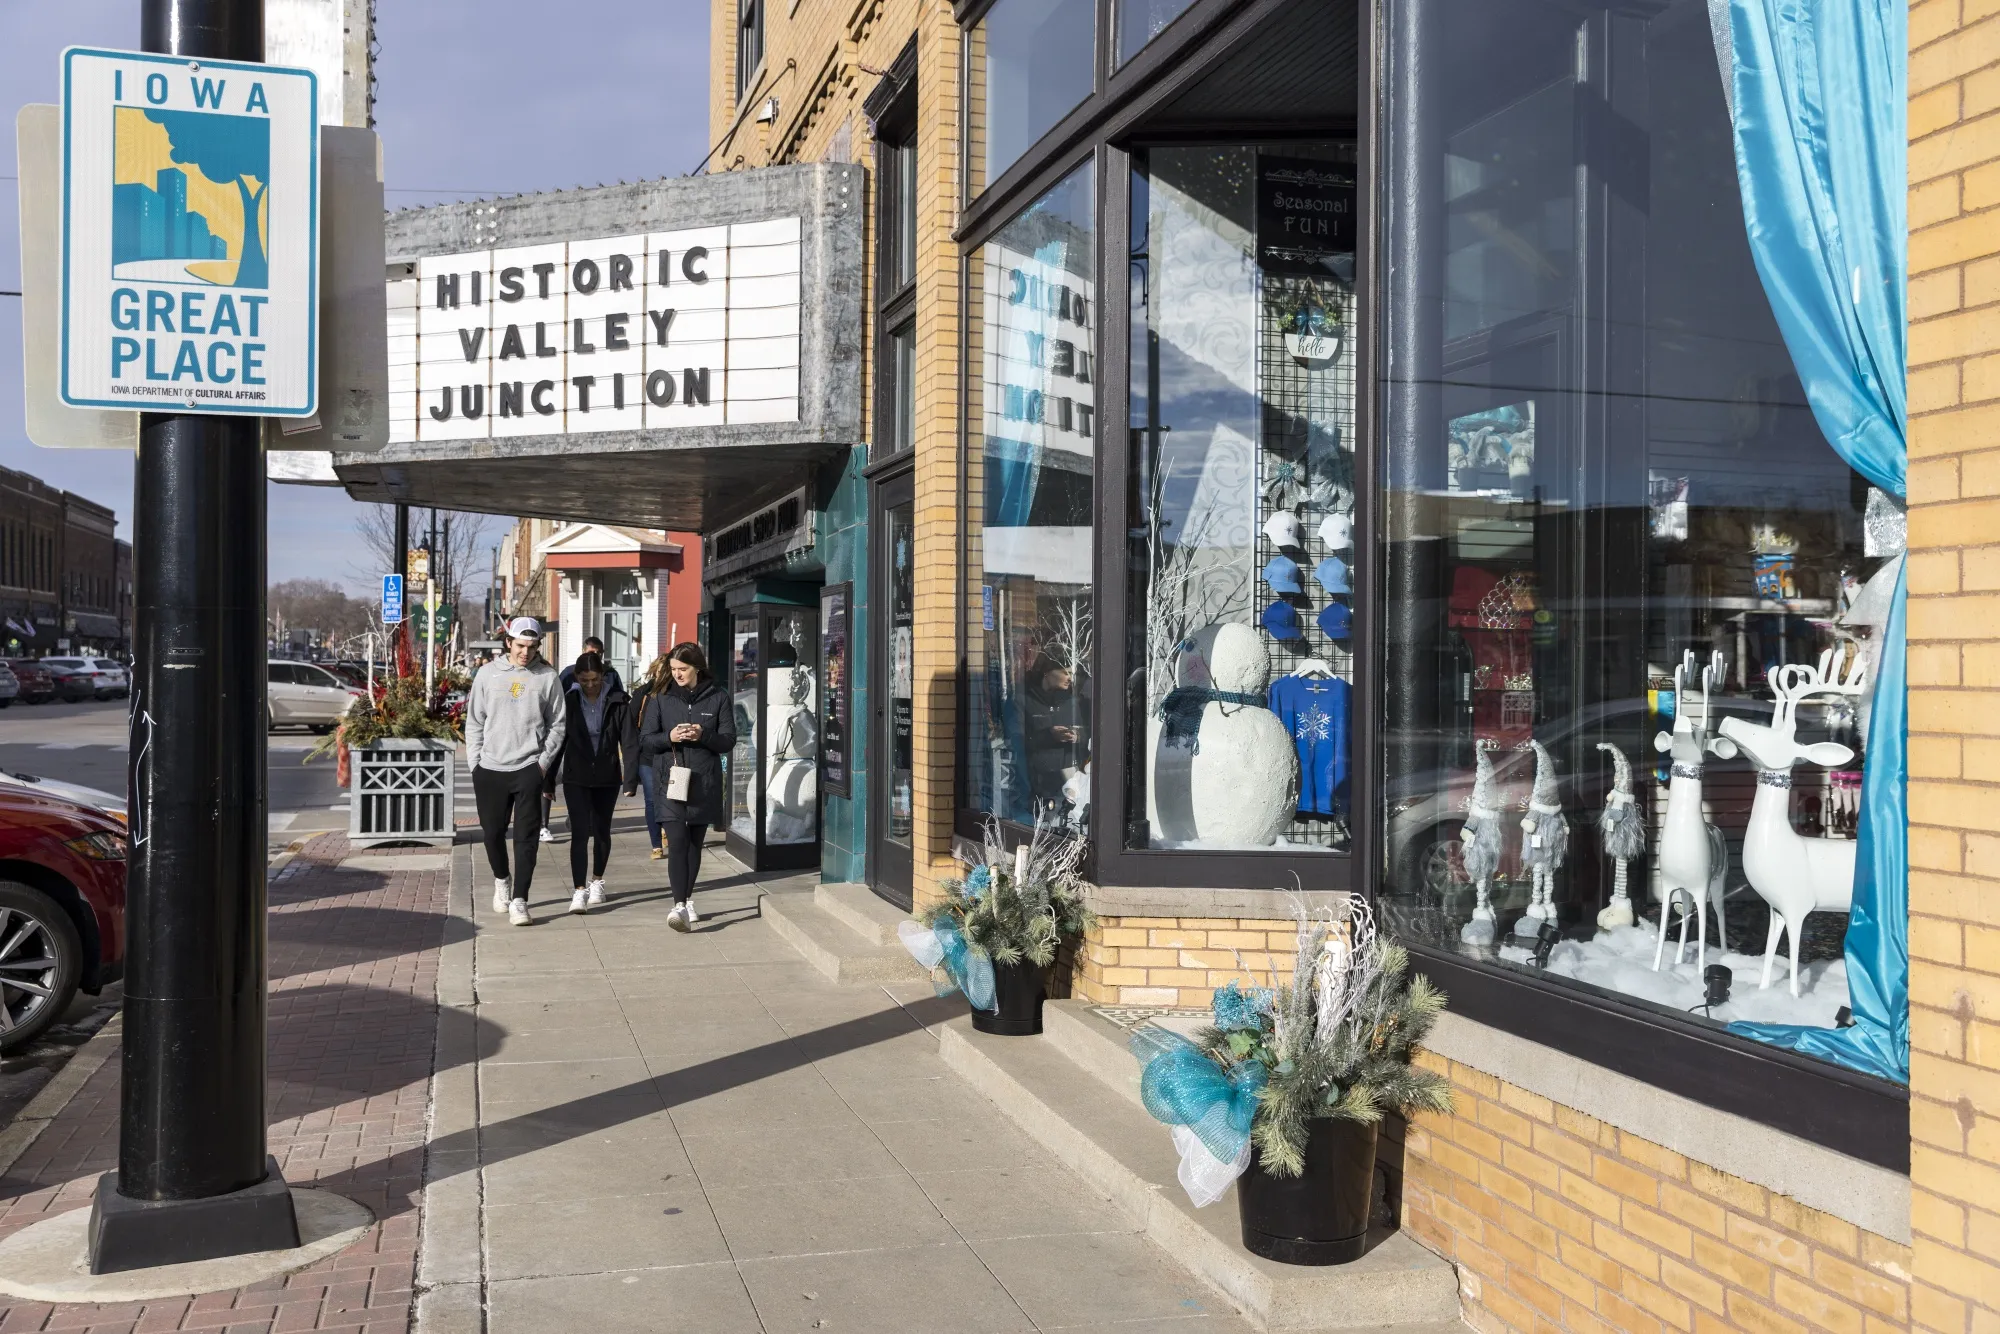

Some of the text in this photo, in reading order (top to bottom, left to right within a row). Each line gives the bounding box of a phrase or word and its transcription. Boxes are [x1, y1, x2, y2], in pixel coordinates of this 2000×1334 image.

[114, 69, 269, 114] IOWA
[1273, 191, 1348, 213] Seasonal
[1283, 216, 1339, 236] FUN!
[436, 246, 708, 309] HISTORIC
[111, 287, 269, 337] GREAT
[458, 308, 677, 362] VALLEY
[111, 336, 266, 385] PLACE
[1297, 336, 1326, 357] hello
[111, 385, 266, 400] IOWA DEPARTMENT OF CULTURAL AFFAIRS
[430, 367, 710, 421] JUNCTION
